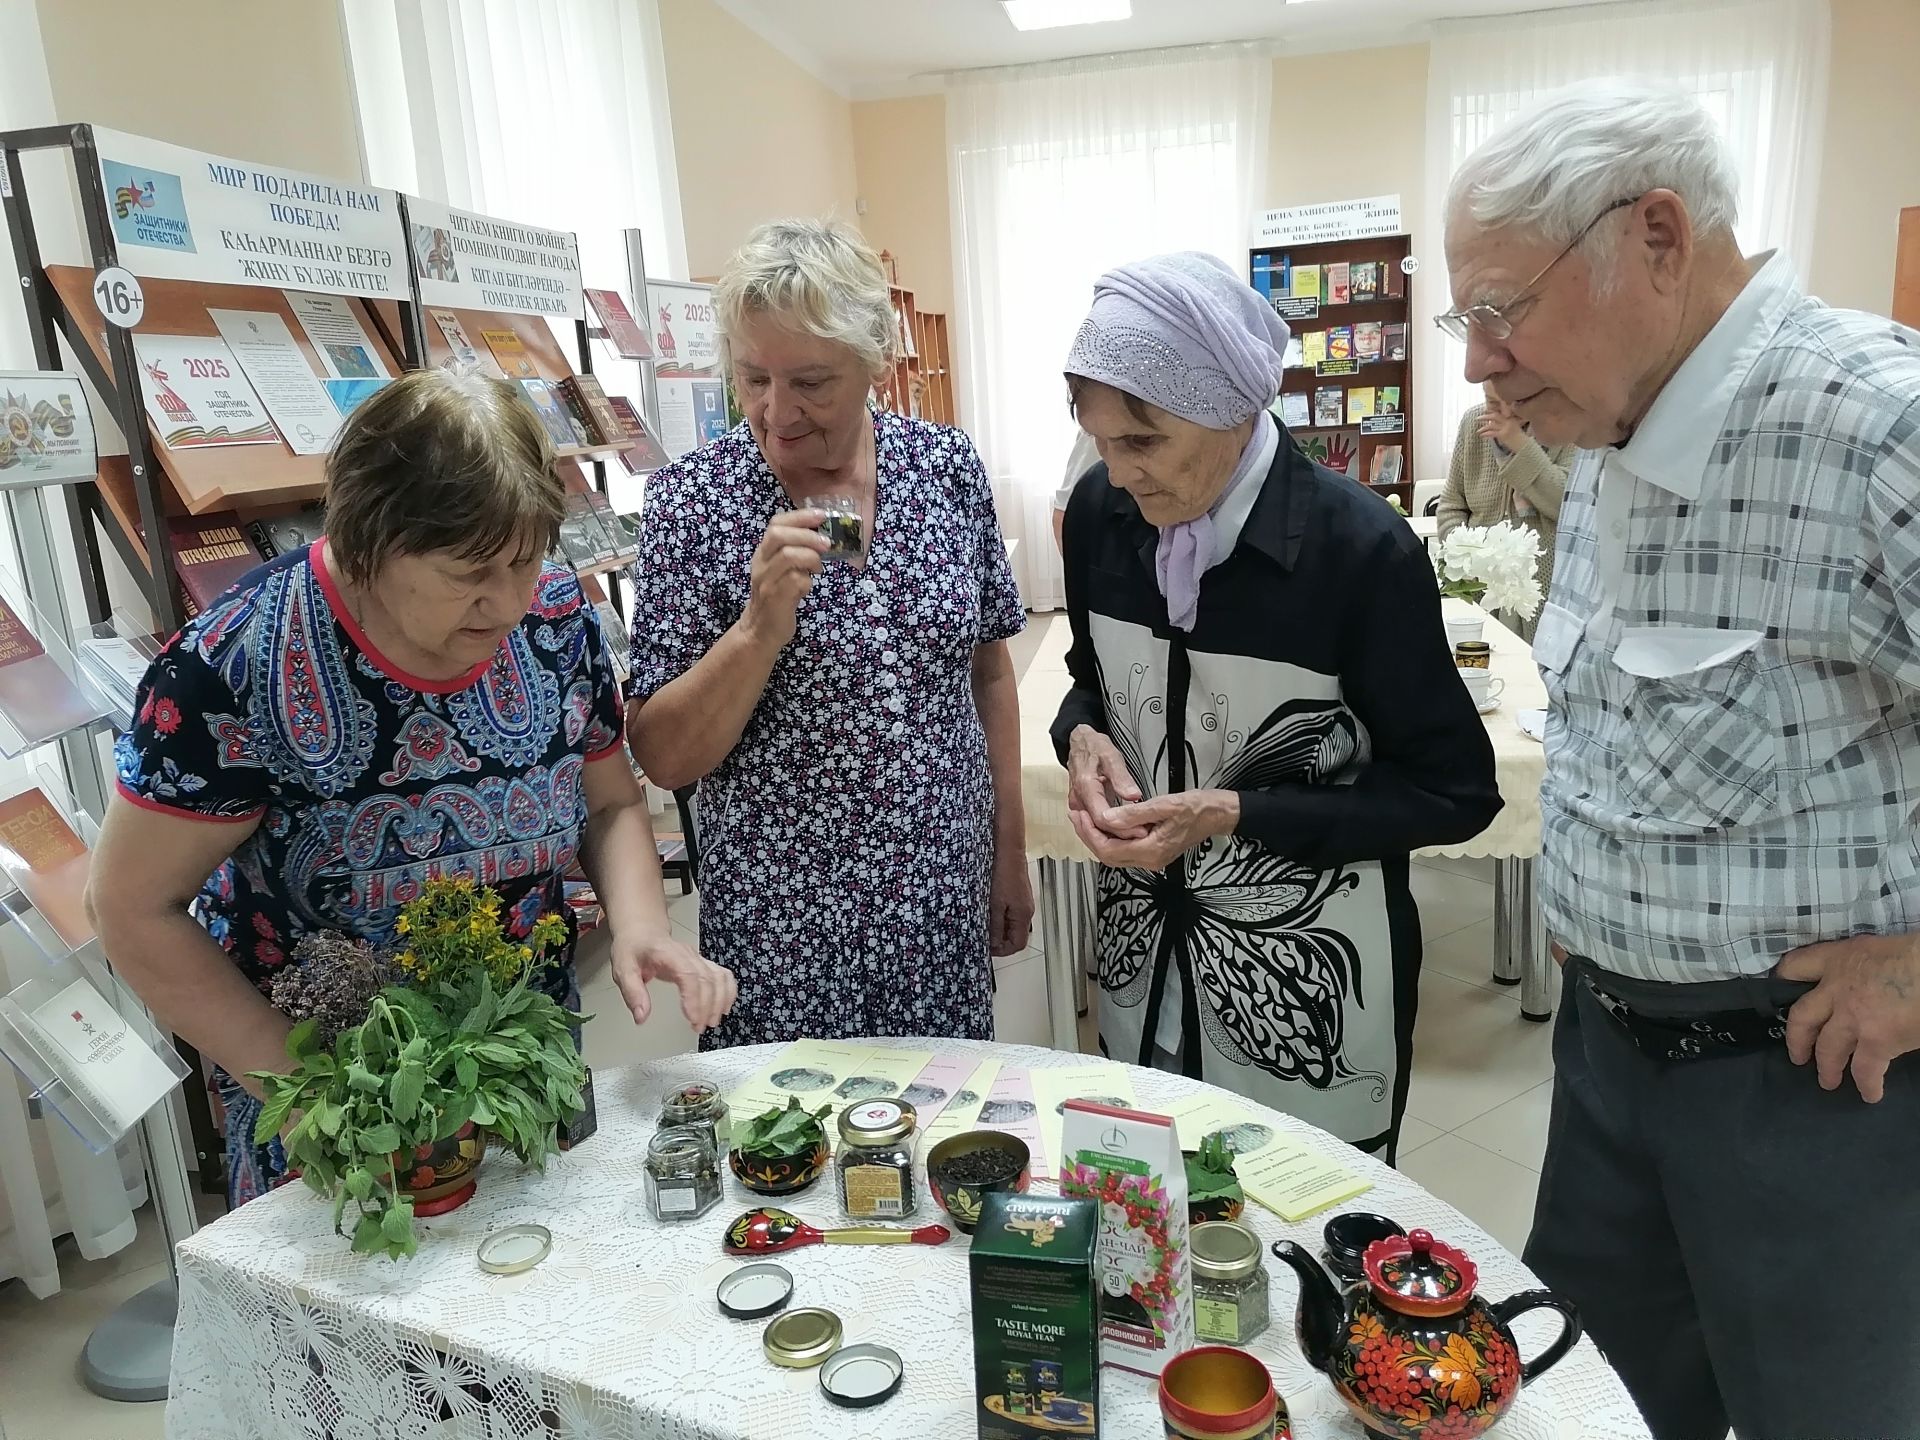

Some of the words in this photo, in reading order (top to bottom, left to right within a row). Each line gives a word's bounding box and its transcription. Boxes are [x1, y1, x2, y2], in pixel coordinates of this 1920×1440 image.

[207, 162, 247, 189] МИР
[251, 172, 343, 207] ПОДАРИЛА
[345, 189, 382, 213] НАМ
[133, 212, 188, 233] ЗАЩИТНИКИ
[269, 202, 341, 232] ПОБЕДА!
[136, 227, 186, 247] ОТЕЧЕСТВА
[449, 213, 492, 239] ЧИТАЕМ
[491, 223, 526, 245] КНИГИ
[526, 231, 535, 244] О
[535, 230, 568, 250] ВОЙНЕ
[346, 245, 392, 268] БЕЗГӘ
[452, 237, 500, 260] ПОМНИМ
[501, 246, 538, 266] ПОДВИГ
[539, 254, 578, 273] НАРОДА
[1402, 260, 1418, 270] 16+
[346, 270, 390, 293] ИТТЕ!
[470, 266, 505, 286] КИТАП
[96, 280, 143, 315] 16+
[684, 303, 711, 322] 2025
[182, 358, 231, 378] 2025
[205, 399, 250, 409] ЗАЩИТНИКА
[214, 390, 231, 401] ГОД
[213, 409, 255, 419] ОТЕЧЕСТВА
[198, 526, 242, 545] ВЕЛИКАЯ
[177, 541, 251, 566] ОТЕЧЕСТВЕННАЯ
[1006, 1203, 1071, 1216] RICHARD
[1108, 1274, 1120, 1287] 50
[995, 1317, 1029, 1332] TASTE
[1031, 1319, 1066, 1337] MORE
[1006, 1328, 1033, 1340] ROYAL
[1035, 1332, 1055, 1343] TEAS
